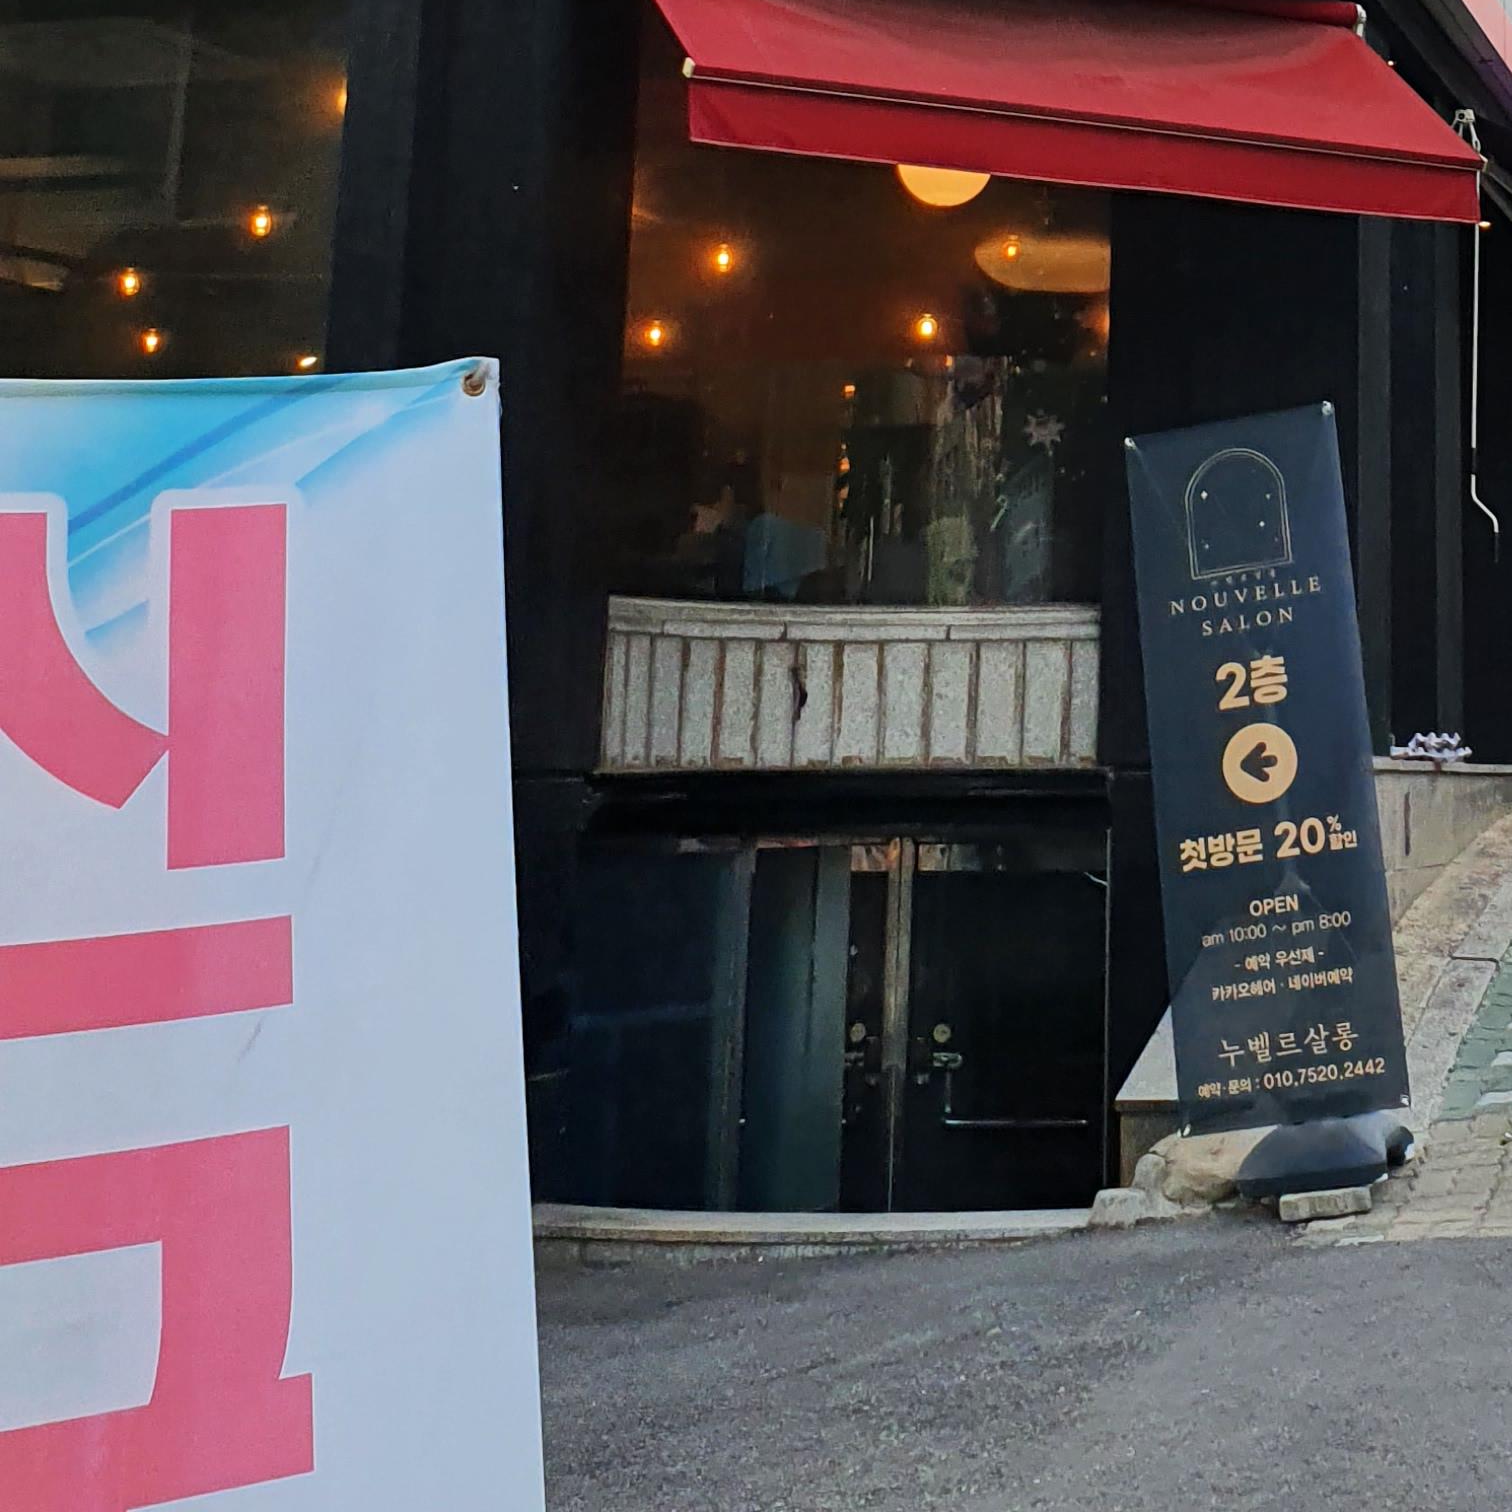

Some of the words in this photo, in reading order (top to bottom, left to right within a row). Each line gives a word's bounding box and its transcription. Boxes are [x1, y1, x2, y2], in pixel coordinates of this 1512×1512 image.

[1168, 574, 1323, 616] NOUVELLE
[1202, 606, 1295, 637] SALON
[1215, 654, 1288, 712] 2층
[1178, 827, 1265, 873] 첫방문
[1249, 893, 1300, 917] OPEN
[1201, 932, 1225, 949] am
[1229, 922, 1267, 943] 10:00
[1291, 918, 1315, 936] pm
[1319, 910, 1352, 929] 8:00
[1244, 952, 1271, 972] 예약
[1274, 946, 1316, 967] 우선제
[1287, 966, 1354, 991] 네이버예약
[1218, 1021, 1359, 1067] 누벨르살롱
[1263, 1057, 1386, 1090] 010.7520.2442
